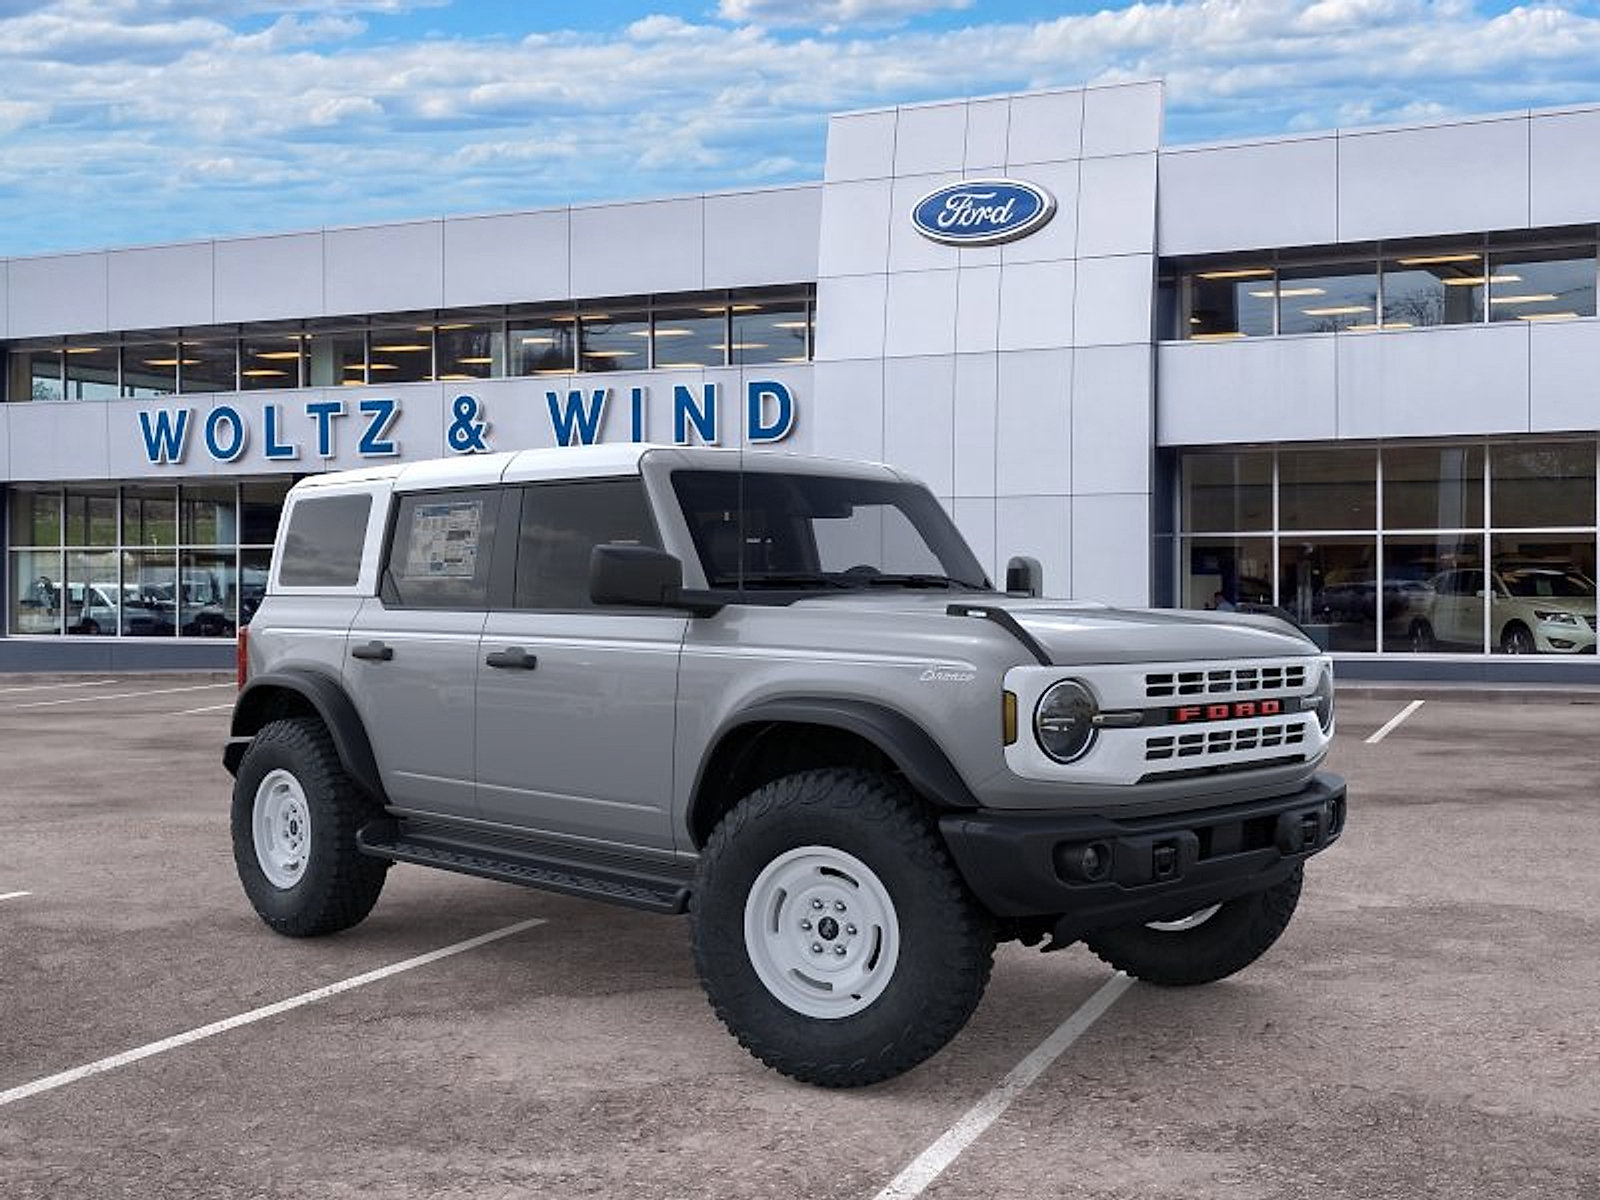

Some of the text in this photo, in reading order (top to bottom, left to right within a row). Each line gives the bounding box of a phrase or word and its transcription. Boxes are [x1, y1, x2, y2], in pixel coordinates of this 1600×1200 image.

[938, 191, 1015, 227] Ford
[138, 380, 795, 464] WOLTZ & WIND
[919, 668, 976, 681] Bronco
[1176, 700, 1280, 722] FORD
